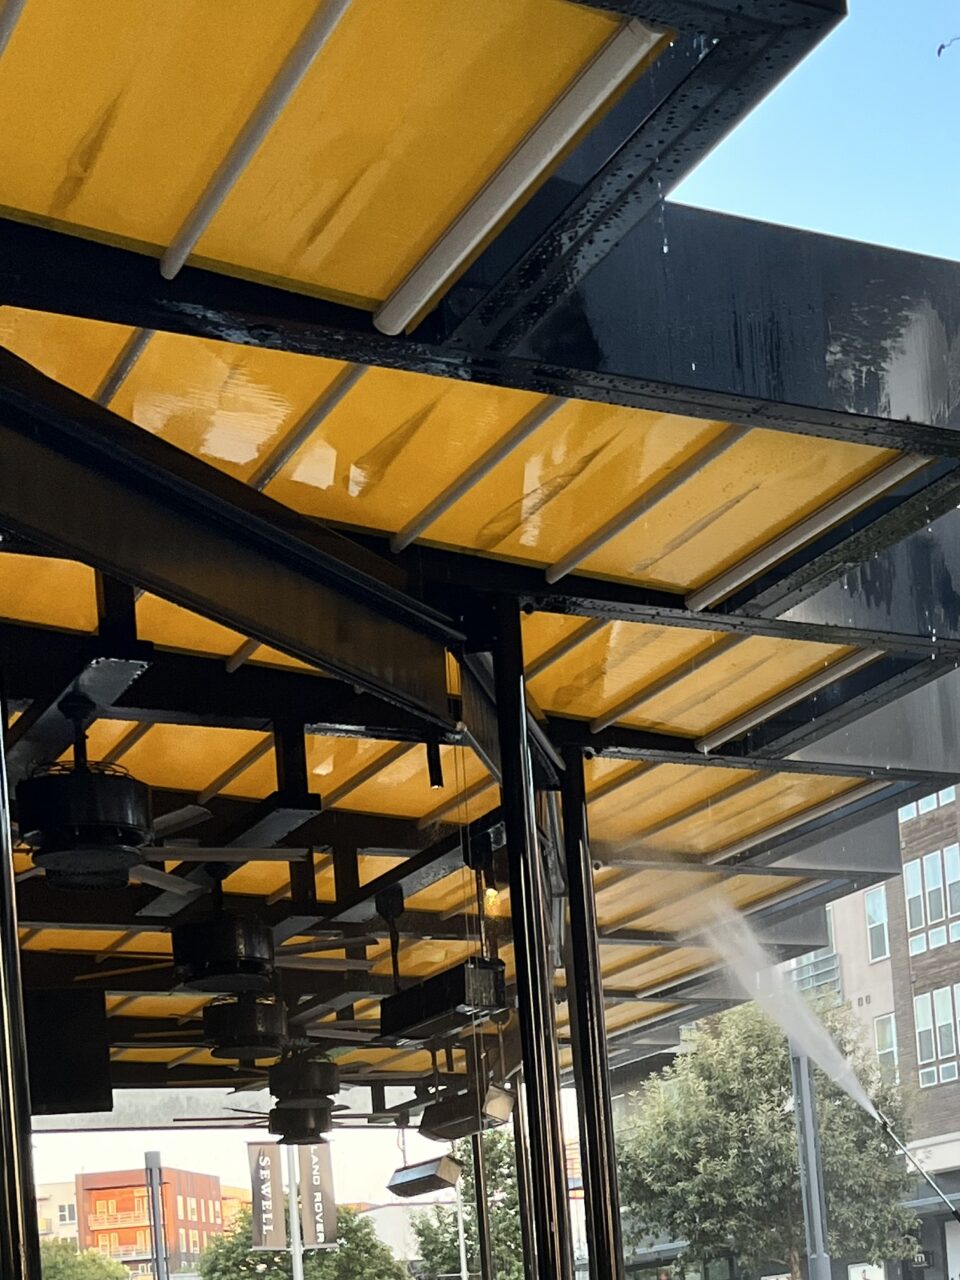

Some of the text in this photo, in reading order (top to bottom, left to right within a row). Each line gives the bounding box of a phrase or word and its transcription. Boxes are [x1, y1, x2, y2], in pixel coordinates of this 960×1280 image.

[259, 1156, 274, 1235] SEWELL
[310, 1145, 325, 1243] LAND ROVER
